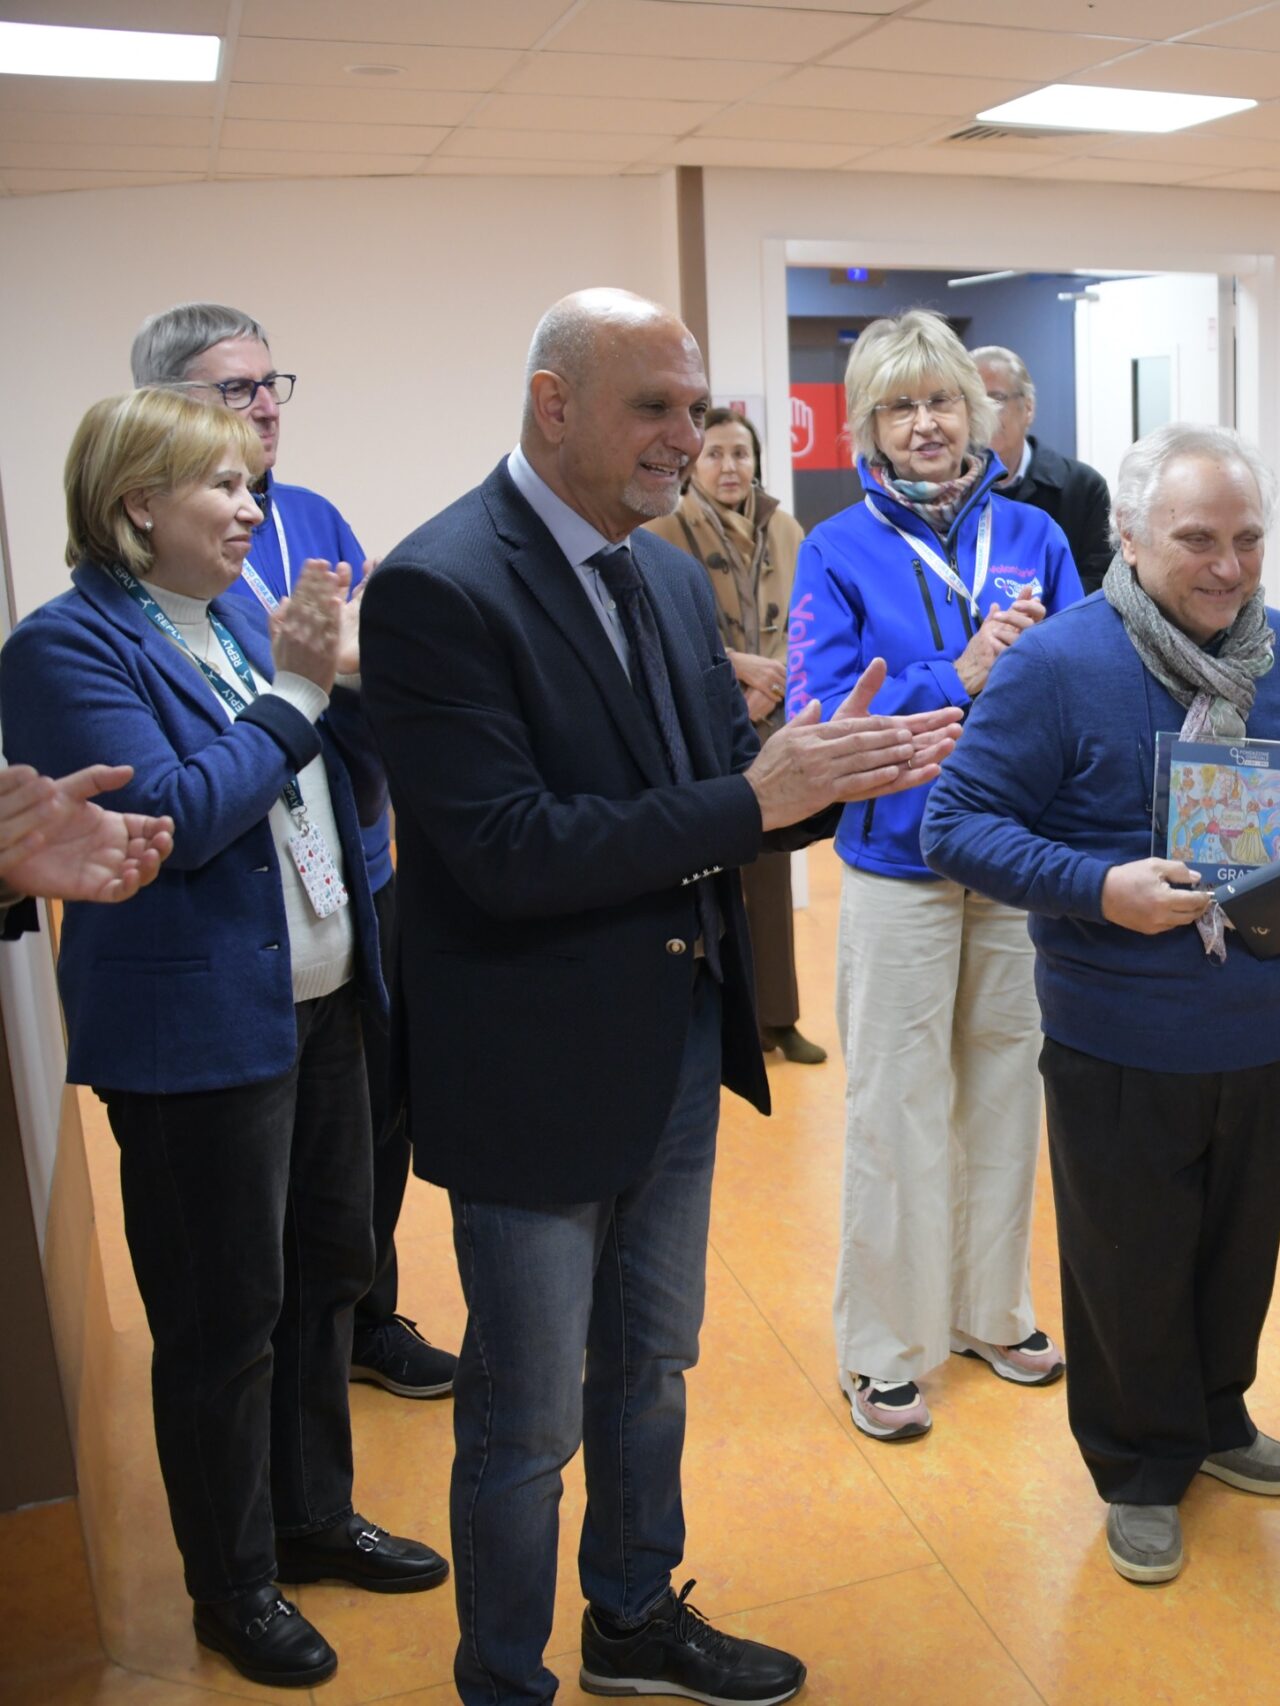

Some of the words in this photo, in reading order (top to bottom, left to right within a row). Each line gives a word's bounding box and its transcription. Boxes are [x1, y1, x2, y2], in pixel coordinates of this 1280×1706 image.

[154, 612, 182, 641] REPLY
[222, 638, 243, 668] REPLY
[788, 593, 816, 720] Volont
[221, 688, 246, 713] EPLY
[284, 783, 300, 807] EPLY
[1217, 867, 1254, 881] GRA
